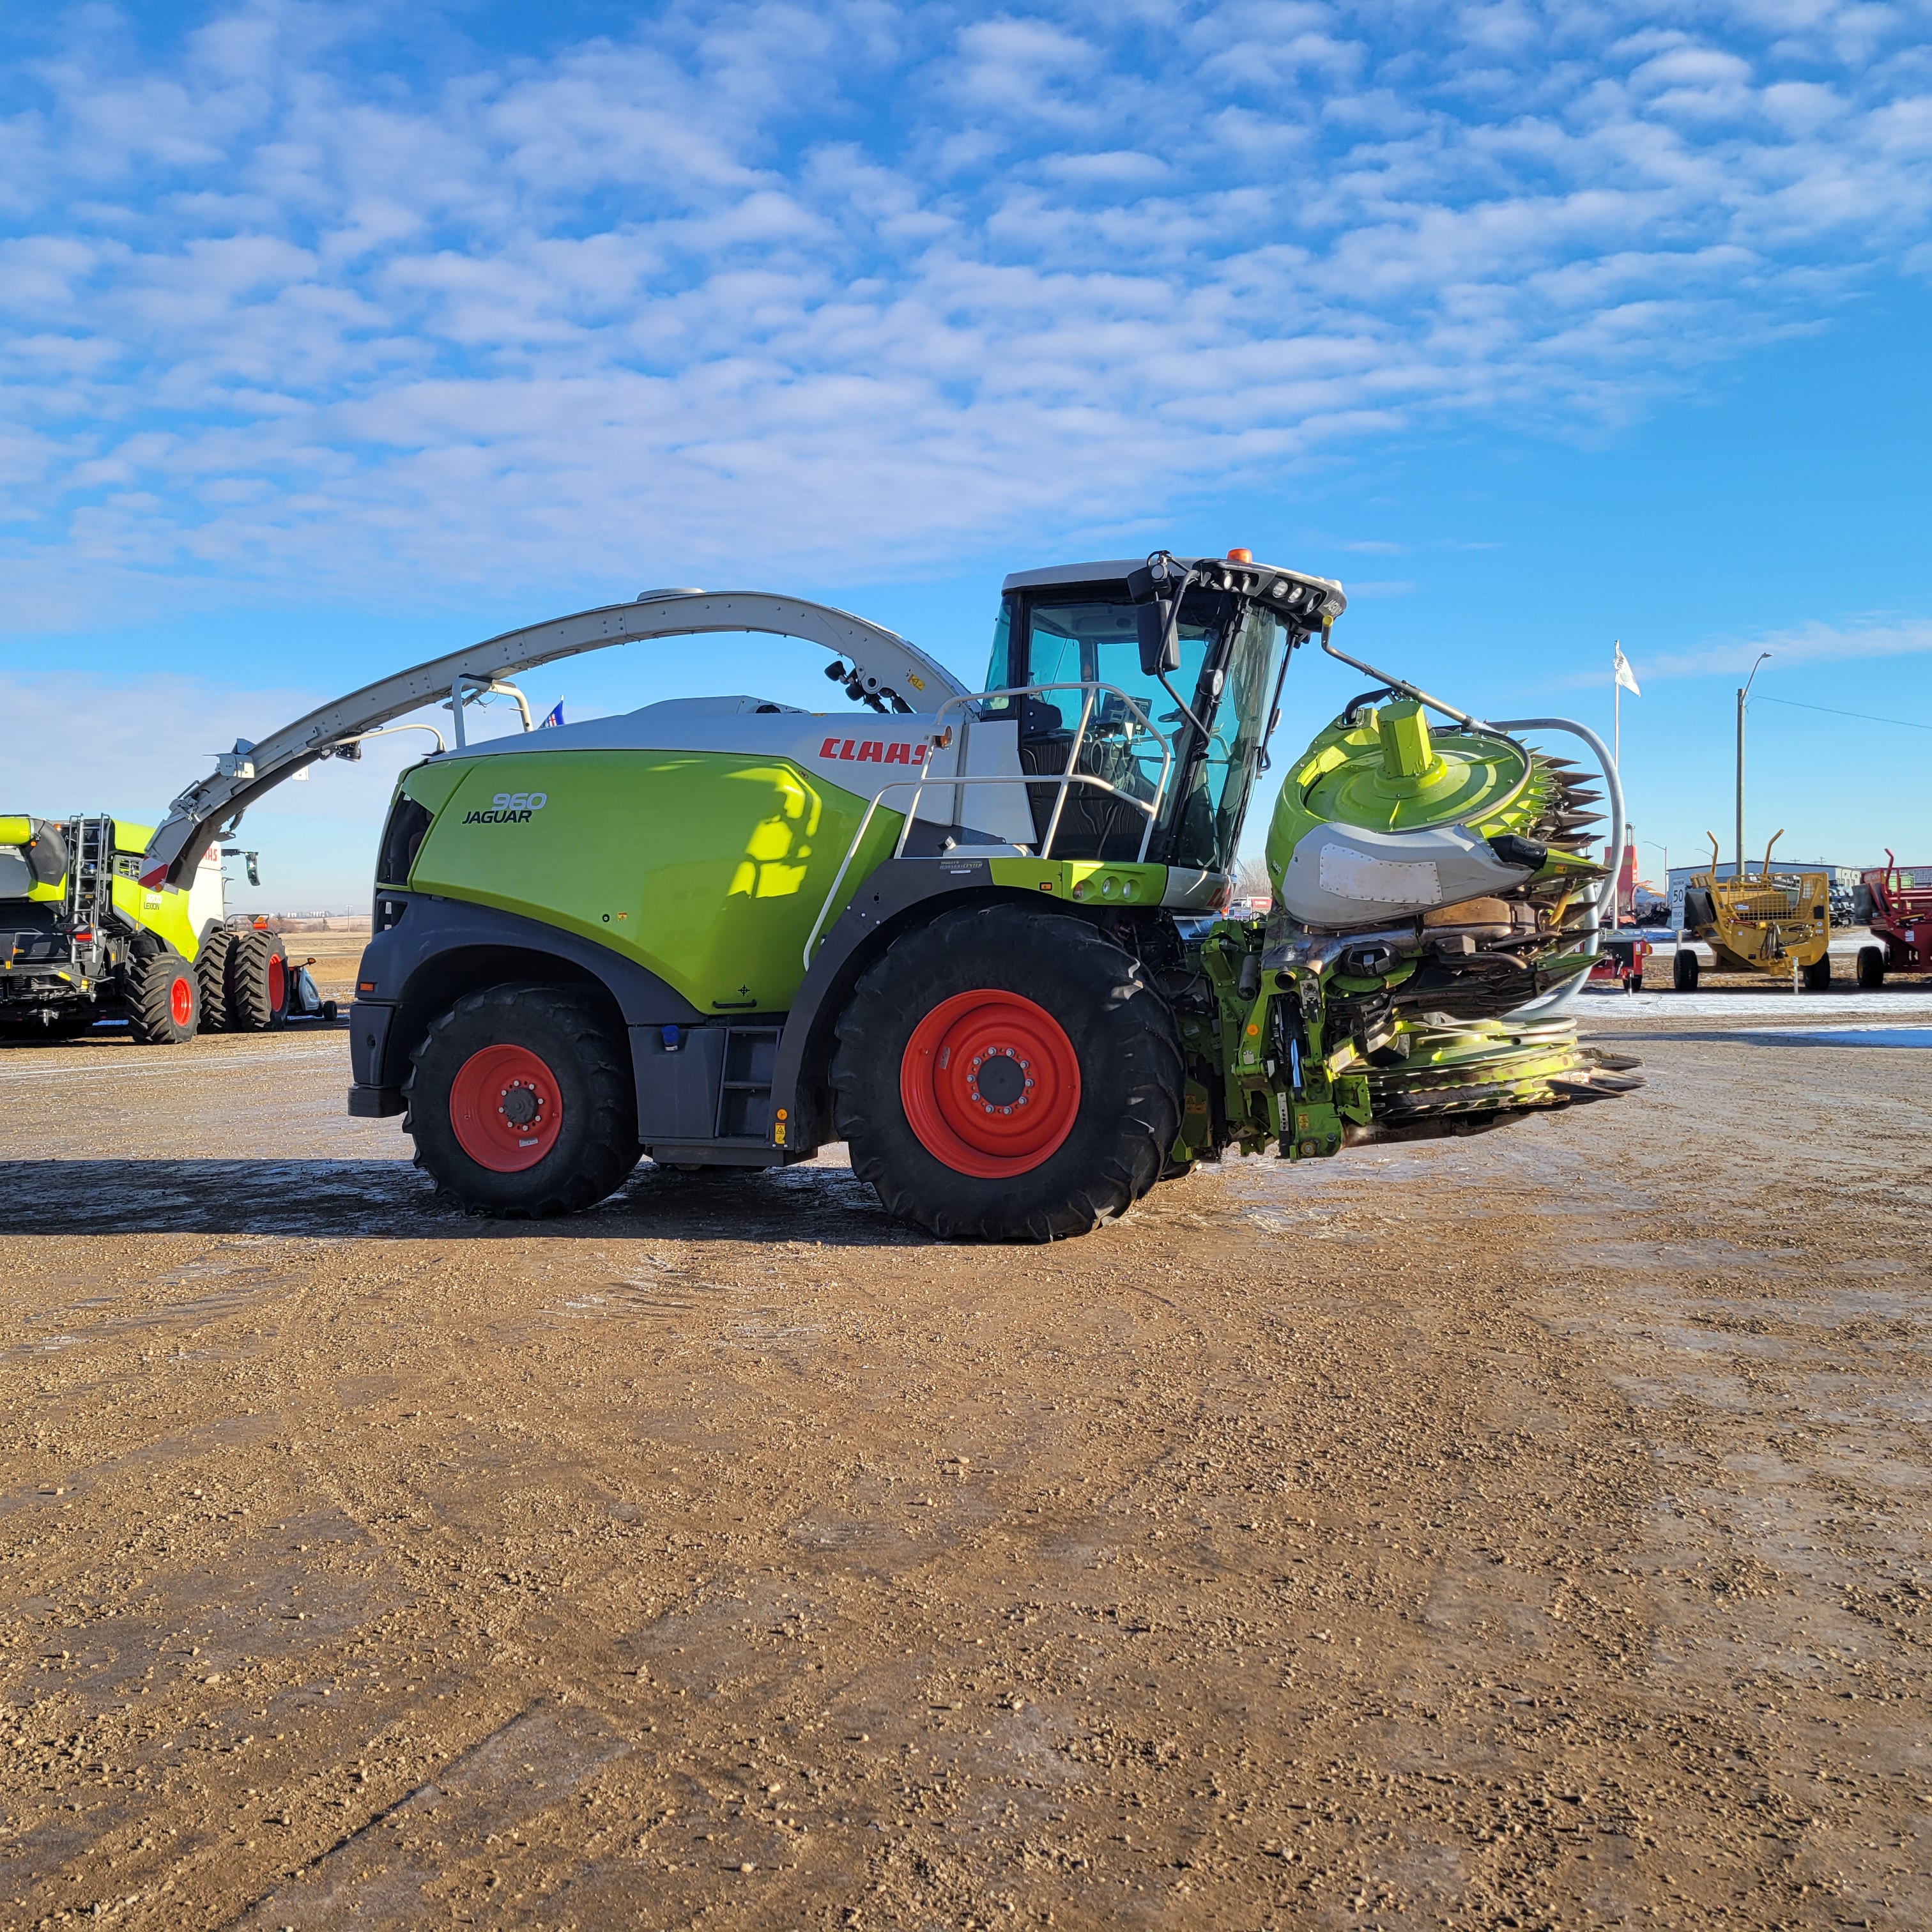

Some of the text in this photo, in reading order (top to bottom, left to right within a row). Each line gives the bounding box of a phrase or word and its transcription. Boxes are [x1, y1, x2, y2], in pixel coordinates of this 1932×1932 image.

[819, 737, 931, 765] CLAAS
[491, 793, 547, 810] 960
[462, 810, 532, 824] JAGUAR
[202, 847, 217, 861] AAS
[1673, 889, 1683, 903] 50
[144, 902, 160, 910] LEXION
